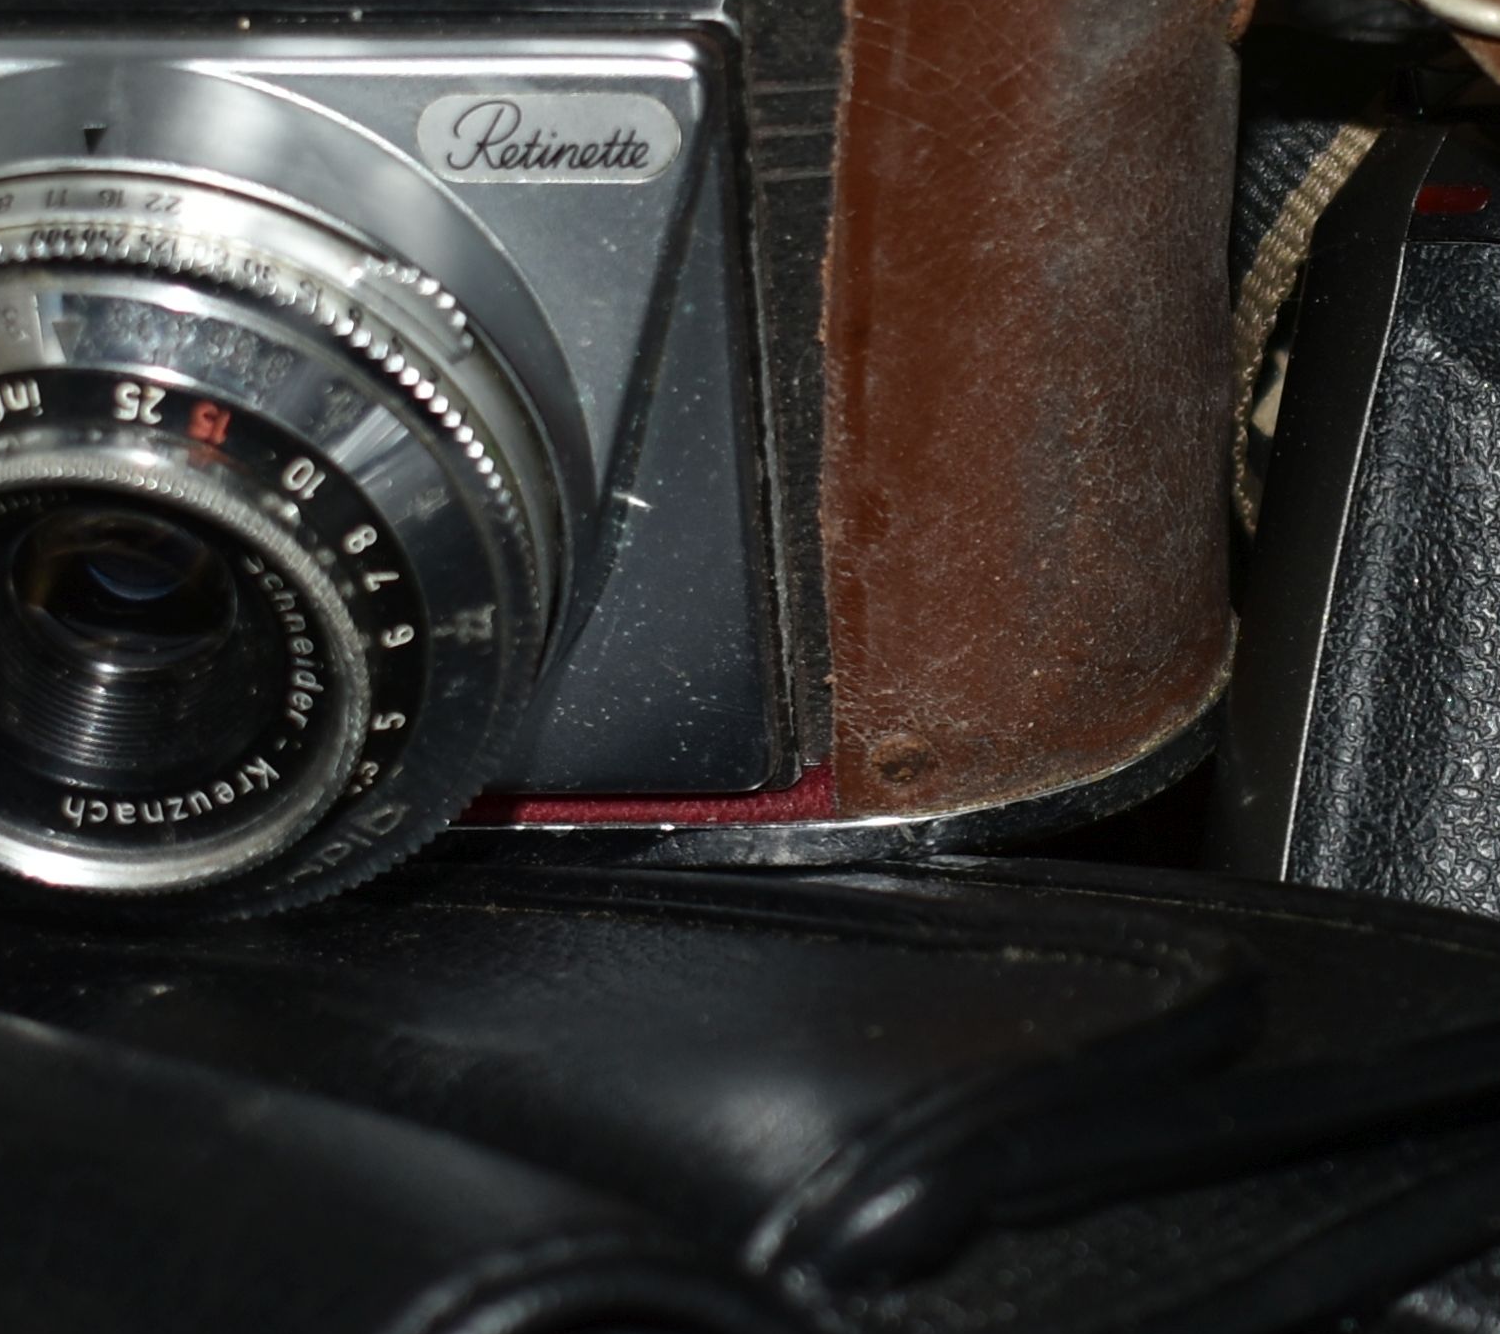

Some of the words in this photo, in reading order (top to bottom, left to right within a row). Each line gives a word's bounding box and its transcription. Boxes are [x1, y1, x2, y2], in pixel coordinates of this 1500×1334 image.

[446, 98, 651, 172] Retinette
[96, 188, 126, 209] 16
[144, 190, 183, 215] 22
[112, 381, 168, 426] 25
[188, 400, 233, 447] 15
[280, 454, 328, 501] 10
[342, 522, 379, 555] 8
[363, 569, 400, 593] 7
[380, 622, 416, 650] 6
[370, 711, 407, 733] 5
[62, 754, 281, 829] Kreuznach
